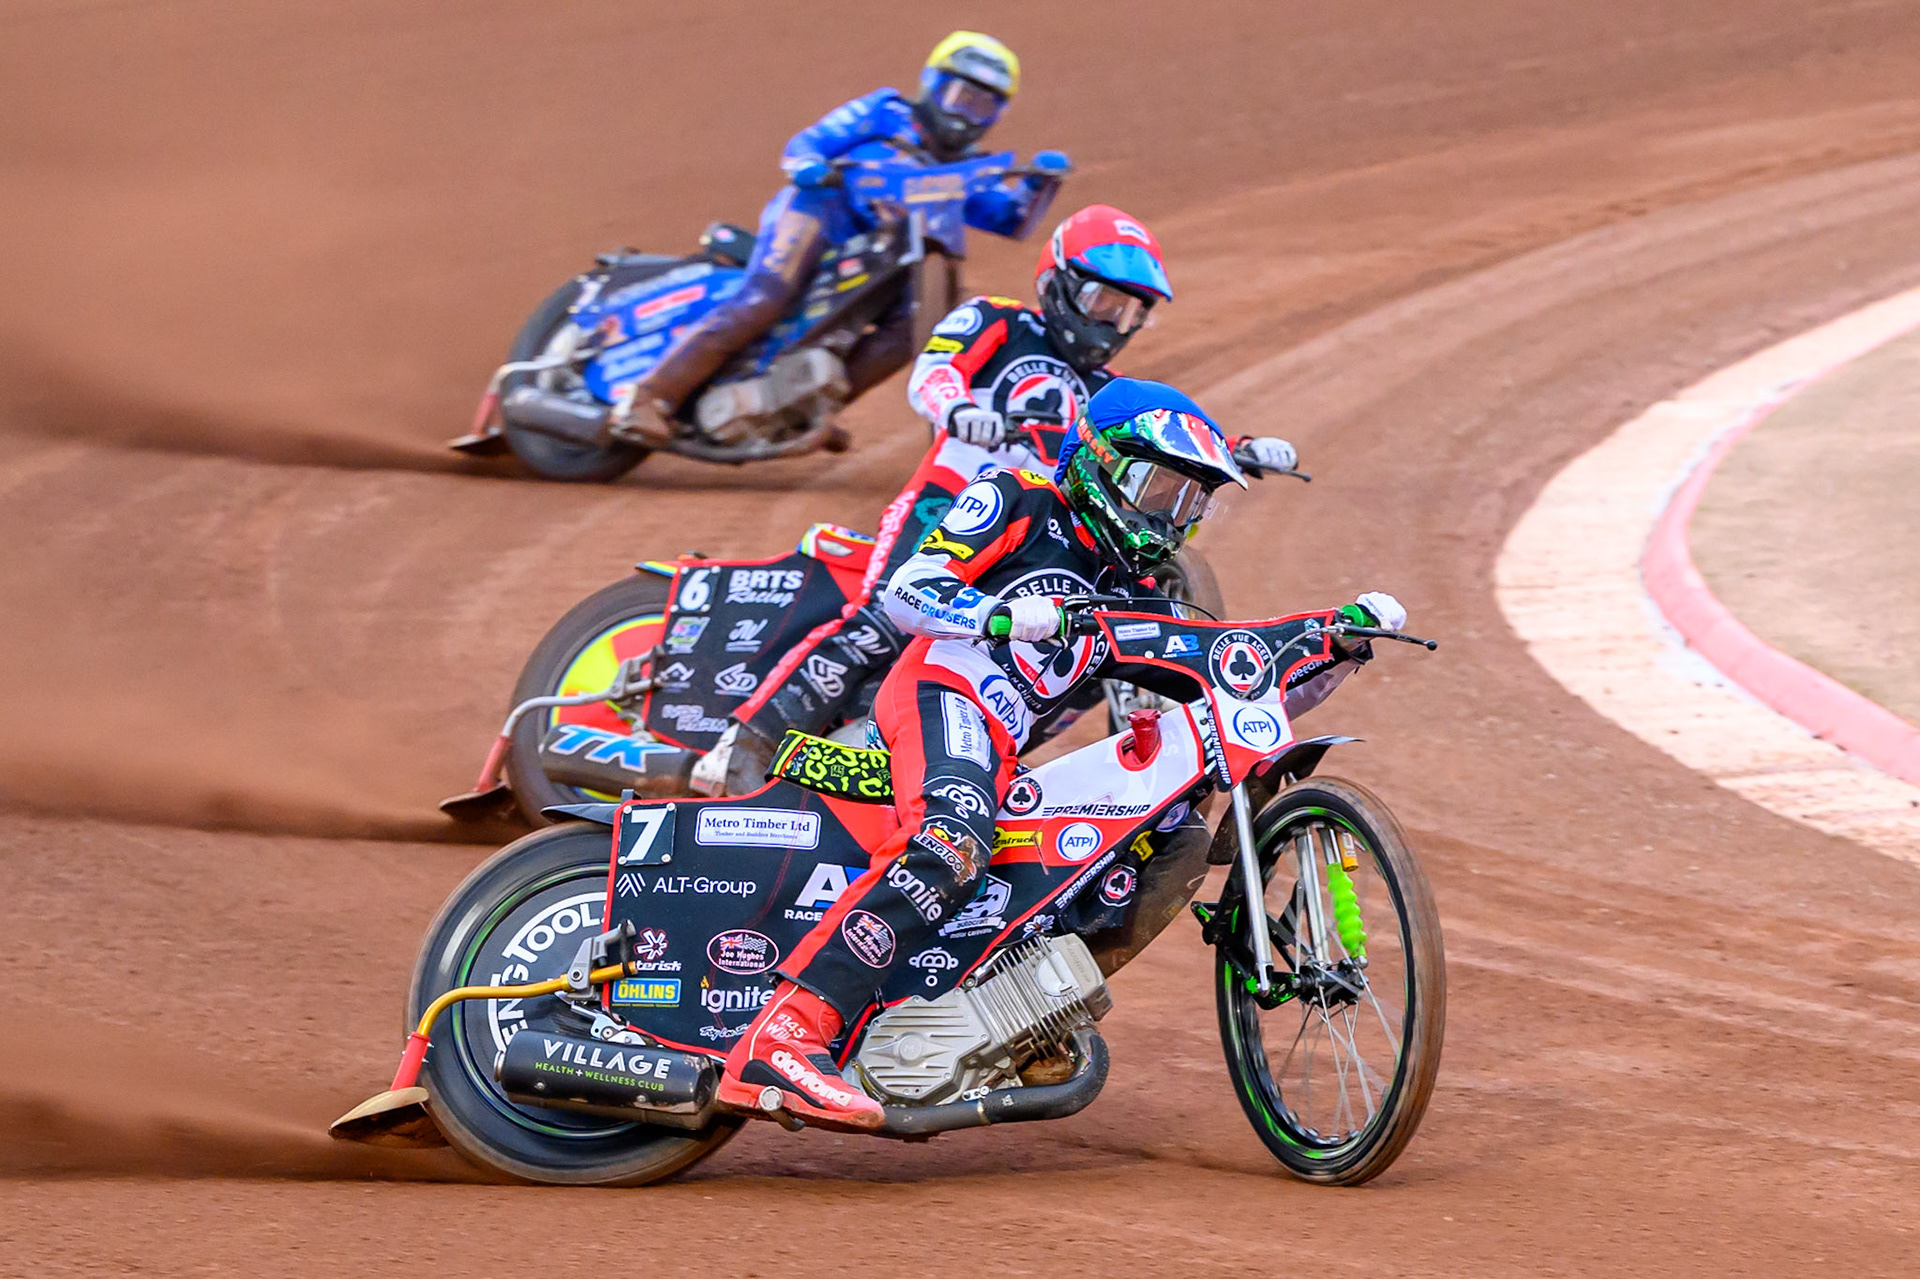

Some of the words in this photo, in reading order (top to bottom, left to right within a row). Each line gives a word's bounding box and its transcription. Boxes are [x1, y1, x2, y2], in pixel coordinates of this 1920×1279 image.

[957, 496, 988, 518] TPI
[679, 569, 711, 611] 6
[729, 570, 804, 590] BRTS
[1015, 577, 1071, 599] BELLE
[894, 586, 922, 611] RACE
[1165, 634, 1199, 654] AB
[1212, 636, 1231, 660] BELLE
[1232, 634, 1249, 642] VUE
[1251, 640, 1269, 660] ACES
[987, 690, 1018, 731] ATPI
[1243, 721, 1272, 733] ATPI
[549, 715, 681, 773] TK
[1050, 804, 1151, 816] PREMIERSHIP
[627, 808, 668, 860] 7
[704, 817, 740, 828] Metro
[743, 817, 787, 830] Timber
[790, 820, 810, 832] Ltd
[1065, 836, 1093, 847] ATPI
[914, 833, 965, 874] ENGTOO
[653, 877, 756, 898] ALT-Group
[1060, 850, 1117, 905] PREMIERSHIP
[886, 863, 942, 921] ignite
[784, 909, 824, 921] RACE
[636, 960, 682, 972] terisk
[719, 958, 765, 968] International
[721, 951, 734, 959] Joe
[736, 951, 764, 961] Hughes
[498, 903, 607, 1045] ENGTOOL
[618, 980, 676, 999] ÖHLINS
[701, 985, 776, 1013] ignite
[543, 1038, 671, 1079] VILLAGE
[535, 1062, 574, 1076] HEALTH
[584, 1070, 635, 1087] WELLNESS
[637, 1080, 664, 1092] CLUB
[771, 1050, 851, 1107] daytona
